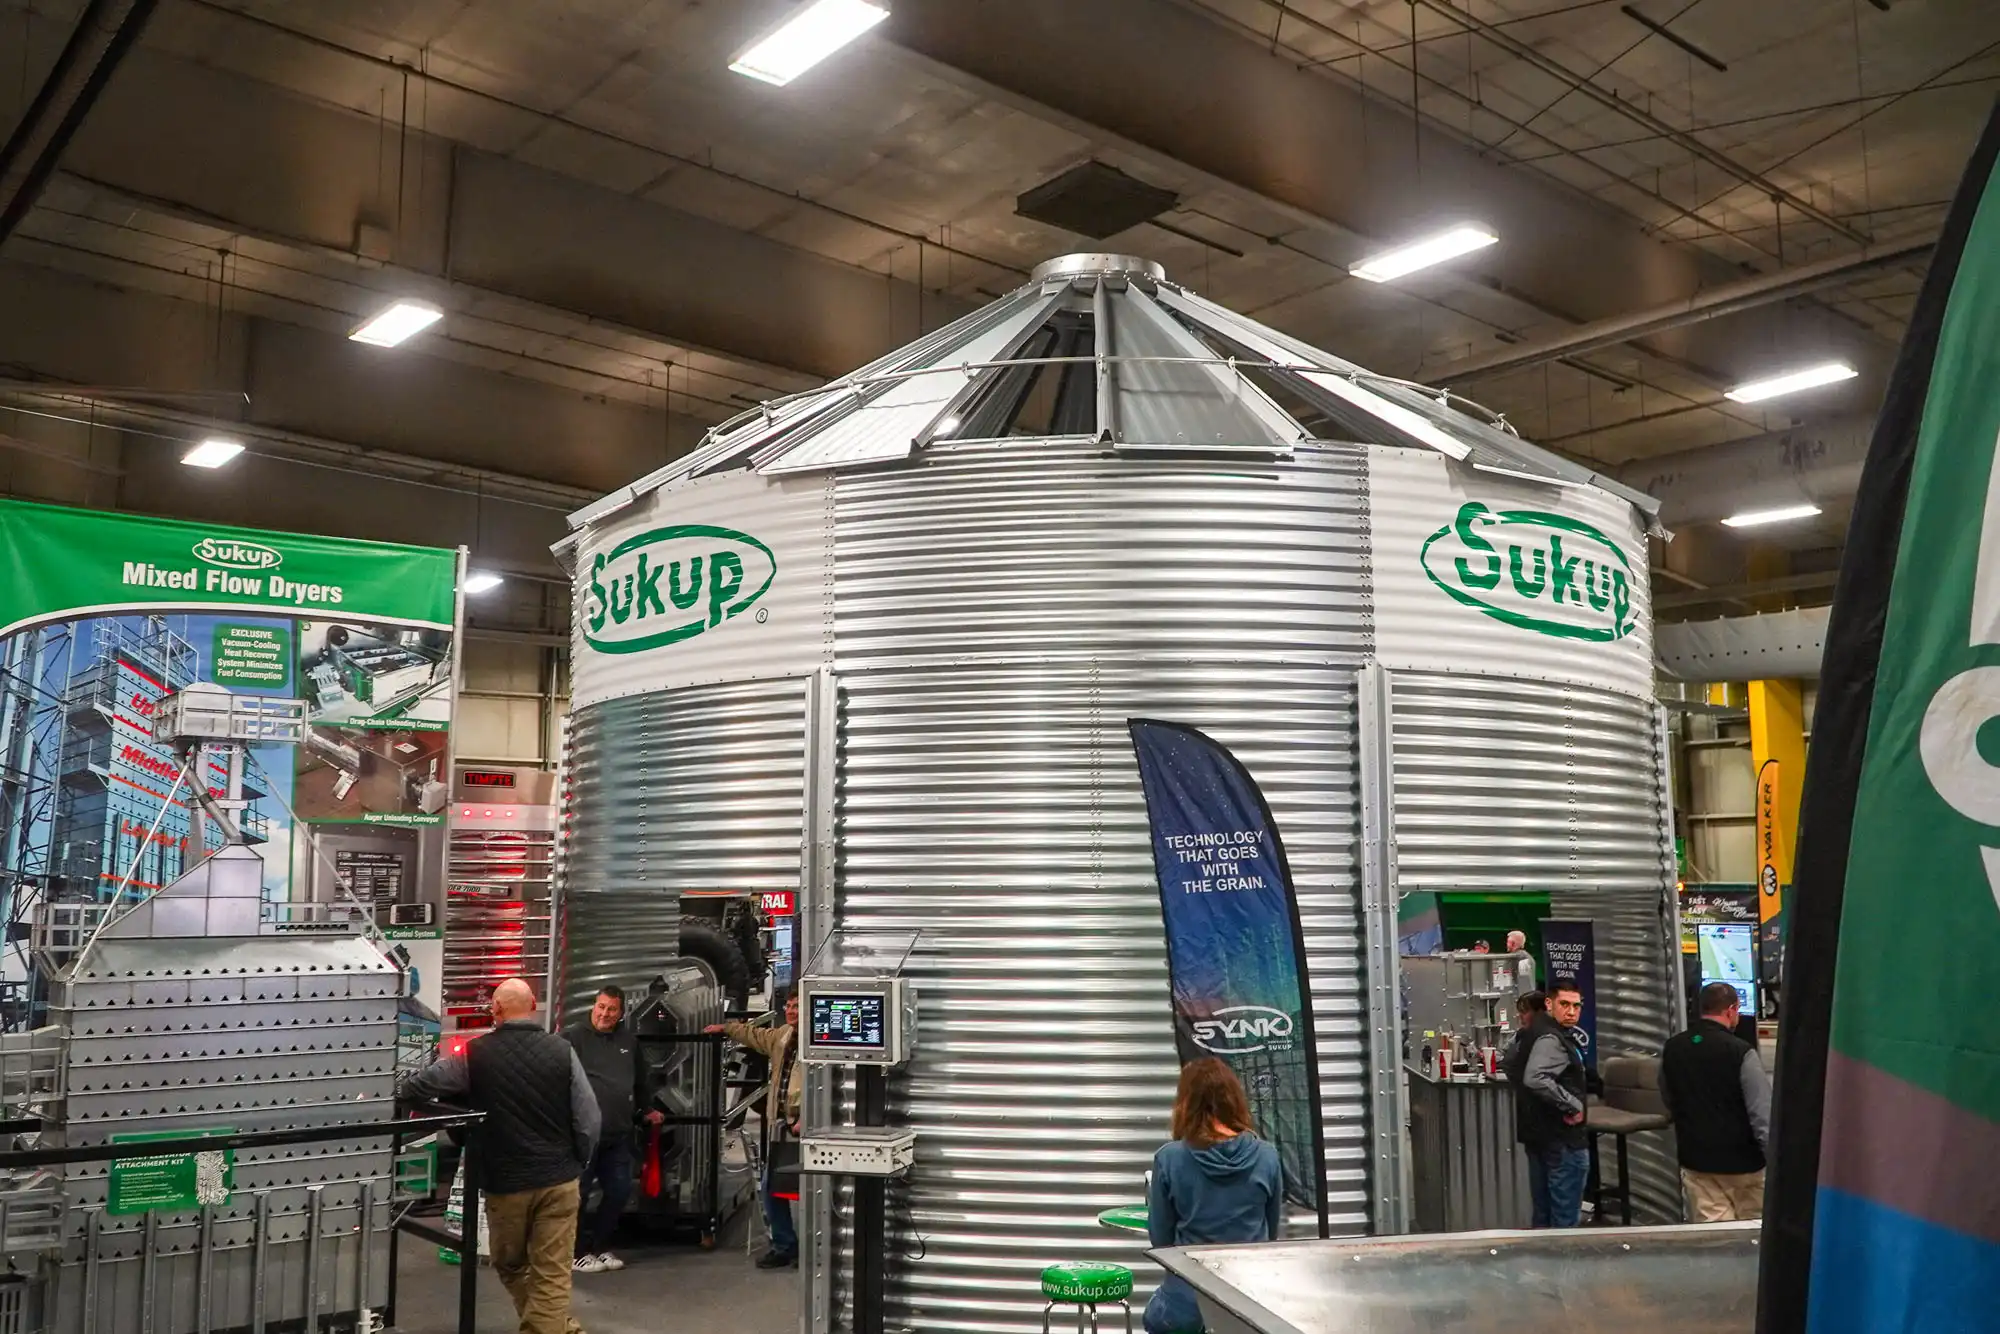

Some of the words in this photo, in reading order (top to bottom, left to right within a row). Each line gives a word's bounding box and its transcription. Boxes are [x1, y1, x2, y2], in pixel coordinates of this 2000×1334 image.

[200, 538, 274, 568] Sukup
[1454, 501, 1630, 640] Sukup
[122, 561, 198, 590] Mixed
[206, 569, 262, 596] Flow
[269, 575, 343, 605] Dryers
[588, 551, 743, 633] Sukup
[230, 628, 273, 639] EXCLUSIVE
[221, 638, 281, 652] Vacuum-Cooling
[224, 649, 242, 657] Heat
[243, 650, 278, 661] Recovery
[217, 658, 245, 668] System
[246, 660, 284, 670] Minimizes
[217, 668, 234, 677] Fuel
[235, 670, 283, 681] Consumption
[386, 719, 416, 728] Unloading
[416, 720, 443, 729] Conveyor
[120, 744, 179, 781] Middle
[363, 814, 383, 822] Auger
[383, 814, 412, 823] Unloading
[412, 815, 440, 824] Conveyor
[1764, 783, 1772, 861] WALKER
[1165, 831, 1263, 849] TECHNOLOGY
[1176, 849, 1213, 863] THAT
[1218, 846, 1259, 860] GOES
[1201, 862, 1239, 877] WITH
[1182, 879, 1213, 894] THE
[1216, 876, 1267, 891] GRAIN.
[1688, 897, 1706, 905] FAST
[1687, 907, 1707, 915] EASY
[392, 930, 413, 938] Control
[414, 930, 436, 939] System
[1546, 942, 1586, 952] TECHNOLOGY
[1550, 951, 1565, 961] THAT
[1565, 952, 1583, 961] GOES
[1552, 961, 1567, 969] WITH
[1568, 961, 1580, 970] THE
[1193, 1017, 1288, 1040] SYNK
[114, 1159, 169, 1170] ATTACHMENT
[171, 1158, 185, 1166] KIT
[1042, 1282, 1129, 1299] www.sukup.com
